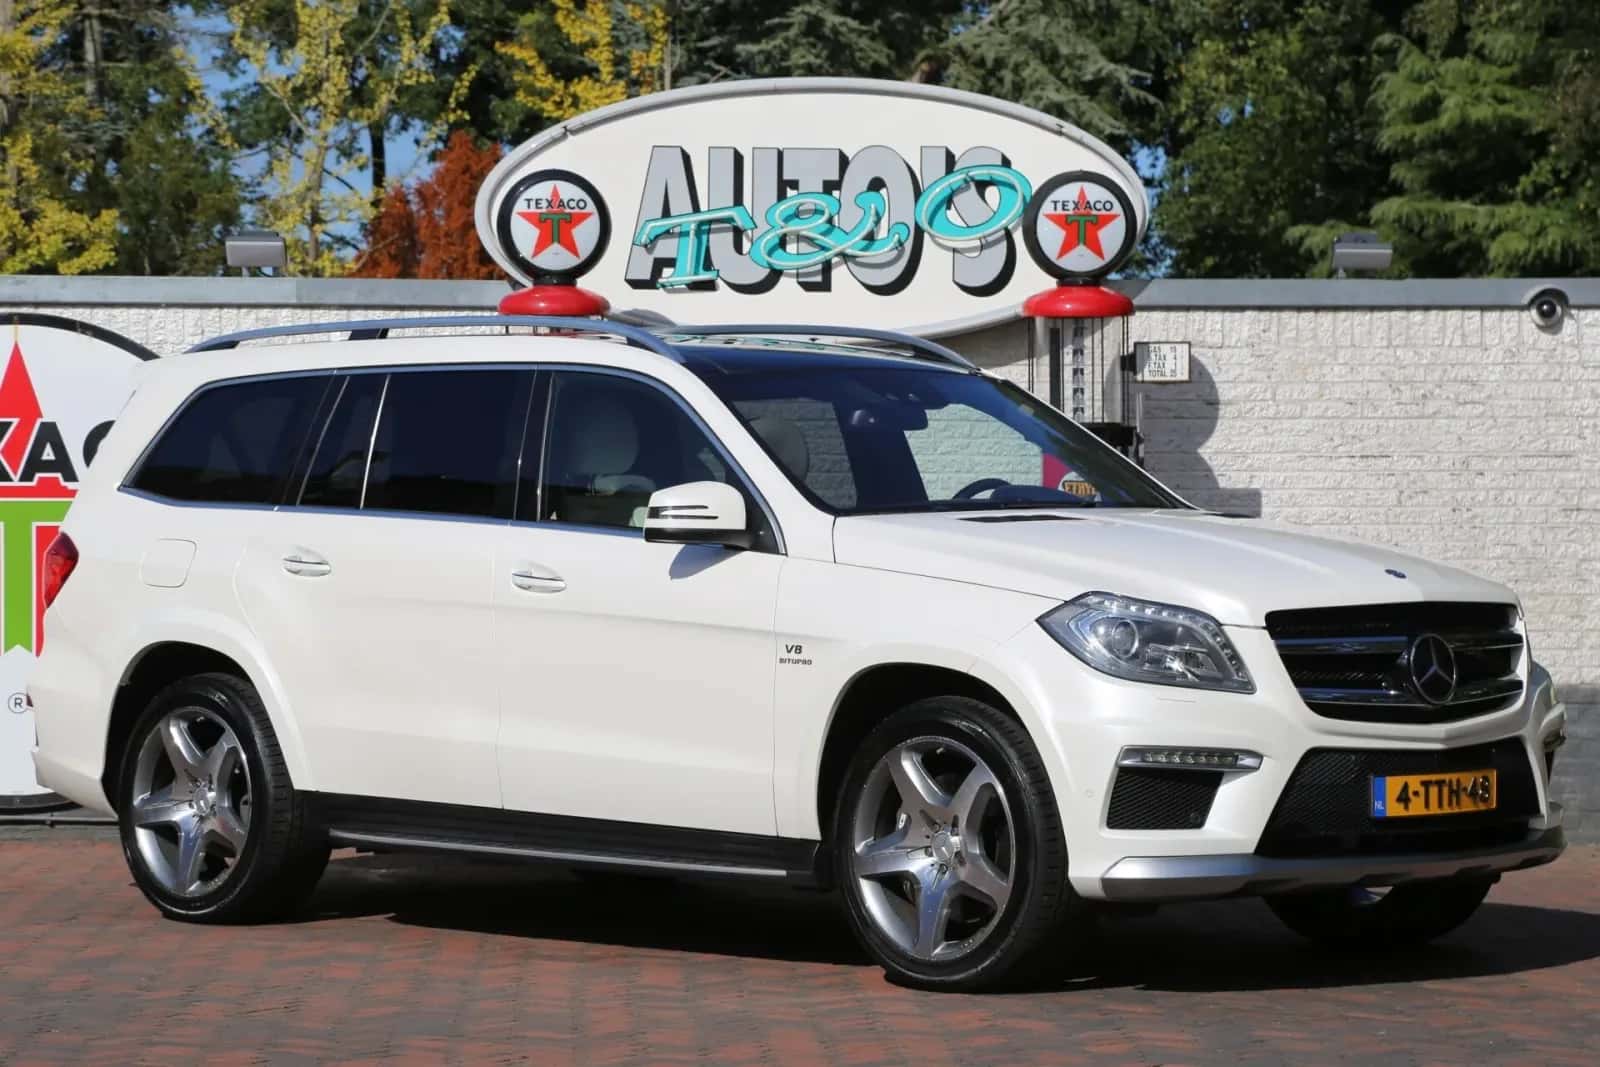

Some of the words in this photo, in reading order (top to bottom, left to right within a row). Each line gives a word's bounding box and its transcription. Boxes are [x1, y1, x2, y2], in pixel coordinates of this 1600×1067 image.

[524, 198, 588, 210] TEXACO
[1051, 200, 1114, 212] TEXACO
[539, 212, 572, 243] T
[625, 144, 1016, 297] AUTO'S
[1066, 214, 1098, 245] T
[785, 644, 803, 655] V8
